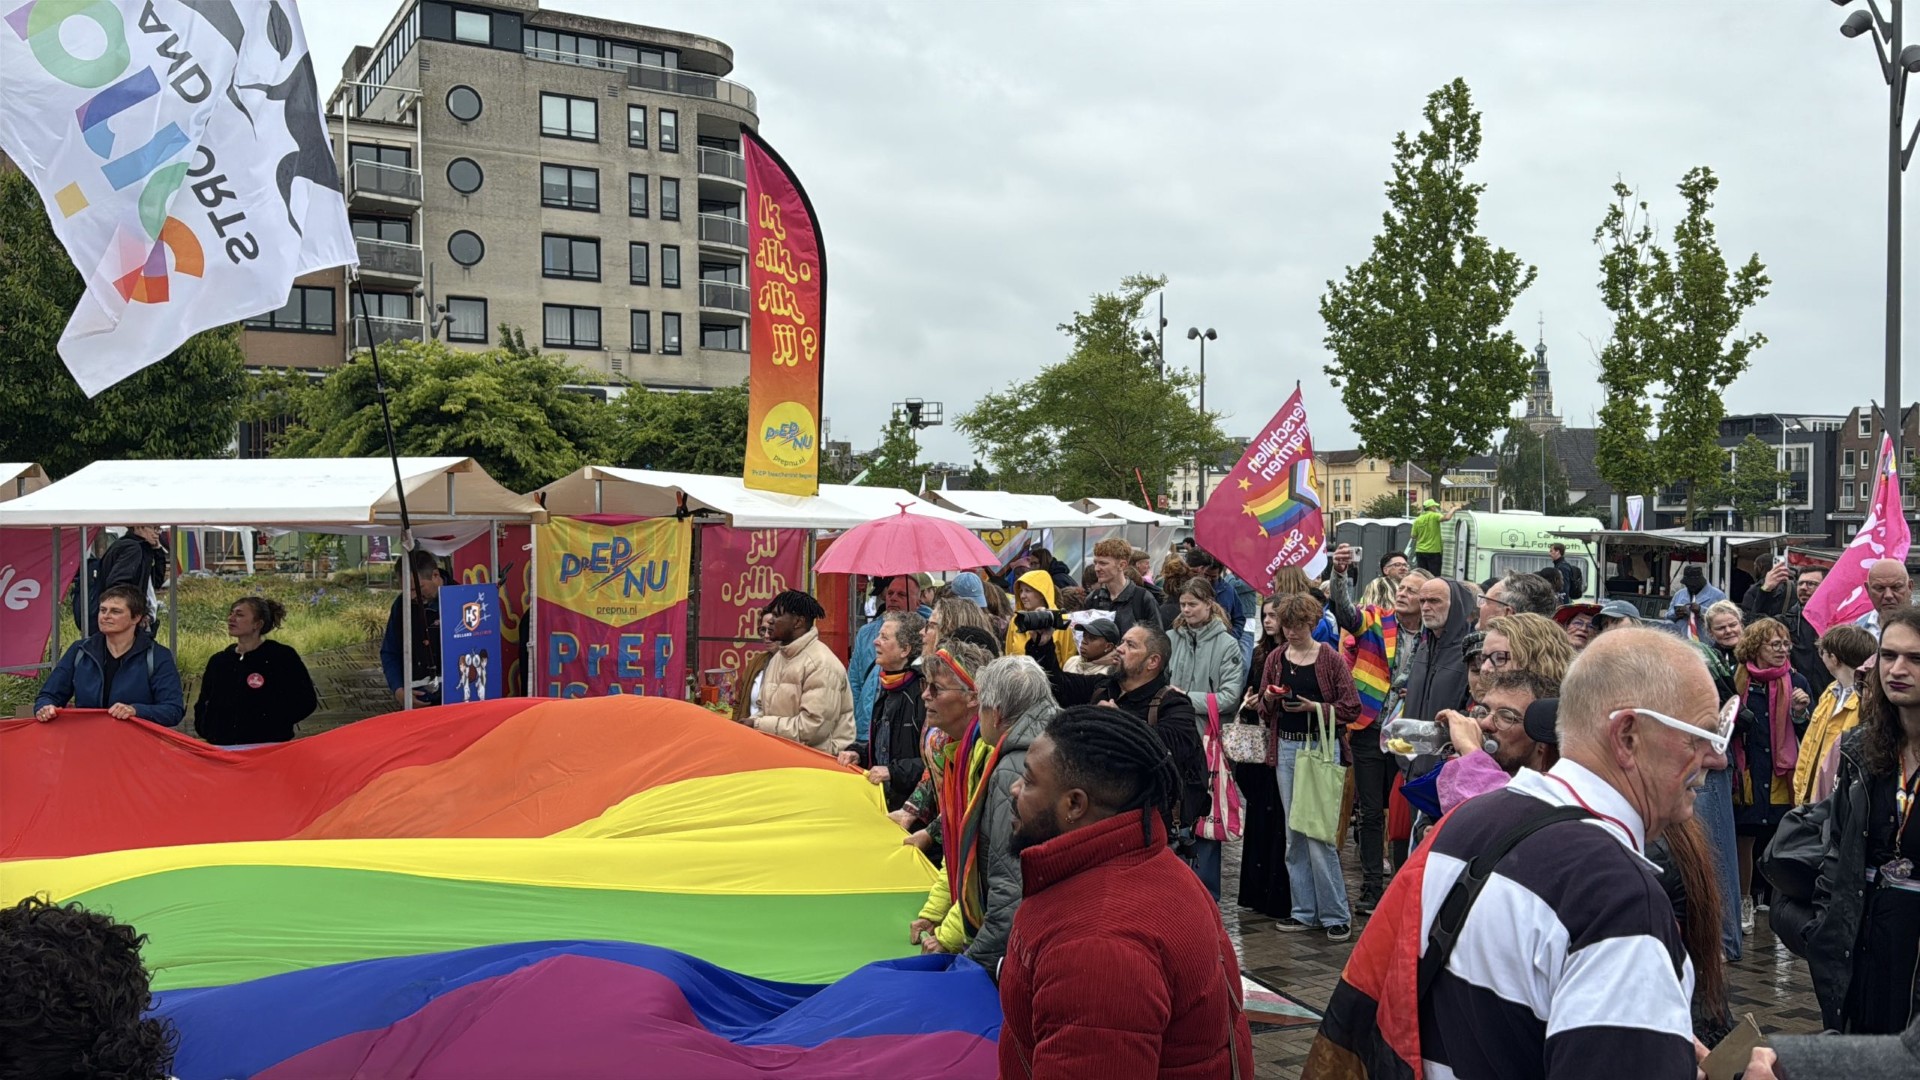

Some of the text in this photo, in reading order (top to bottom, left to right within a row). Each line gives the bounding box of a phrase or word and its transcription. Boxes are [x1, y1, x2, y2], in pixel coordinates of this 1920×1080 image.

[760, 193, 785, 240] Ik
[792, 434, 813, 451] NU
[773, 455, 806, 466] prepnu.nl
[623, 559, 670, 598] NU
[466, 609, 477, 621] HS
[596, 605, 638, 615] prepnu.nl
[548, 631, 674, 679] PrEP
